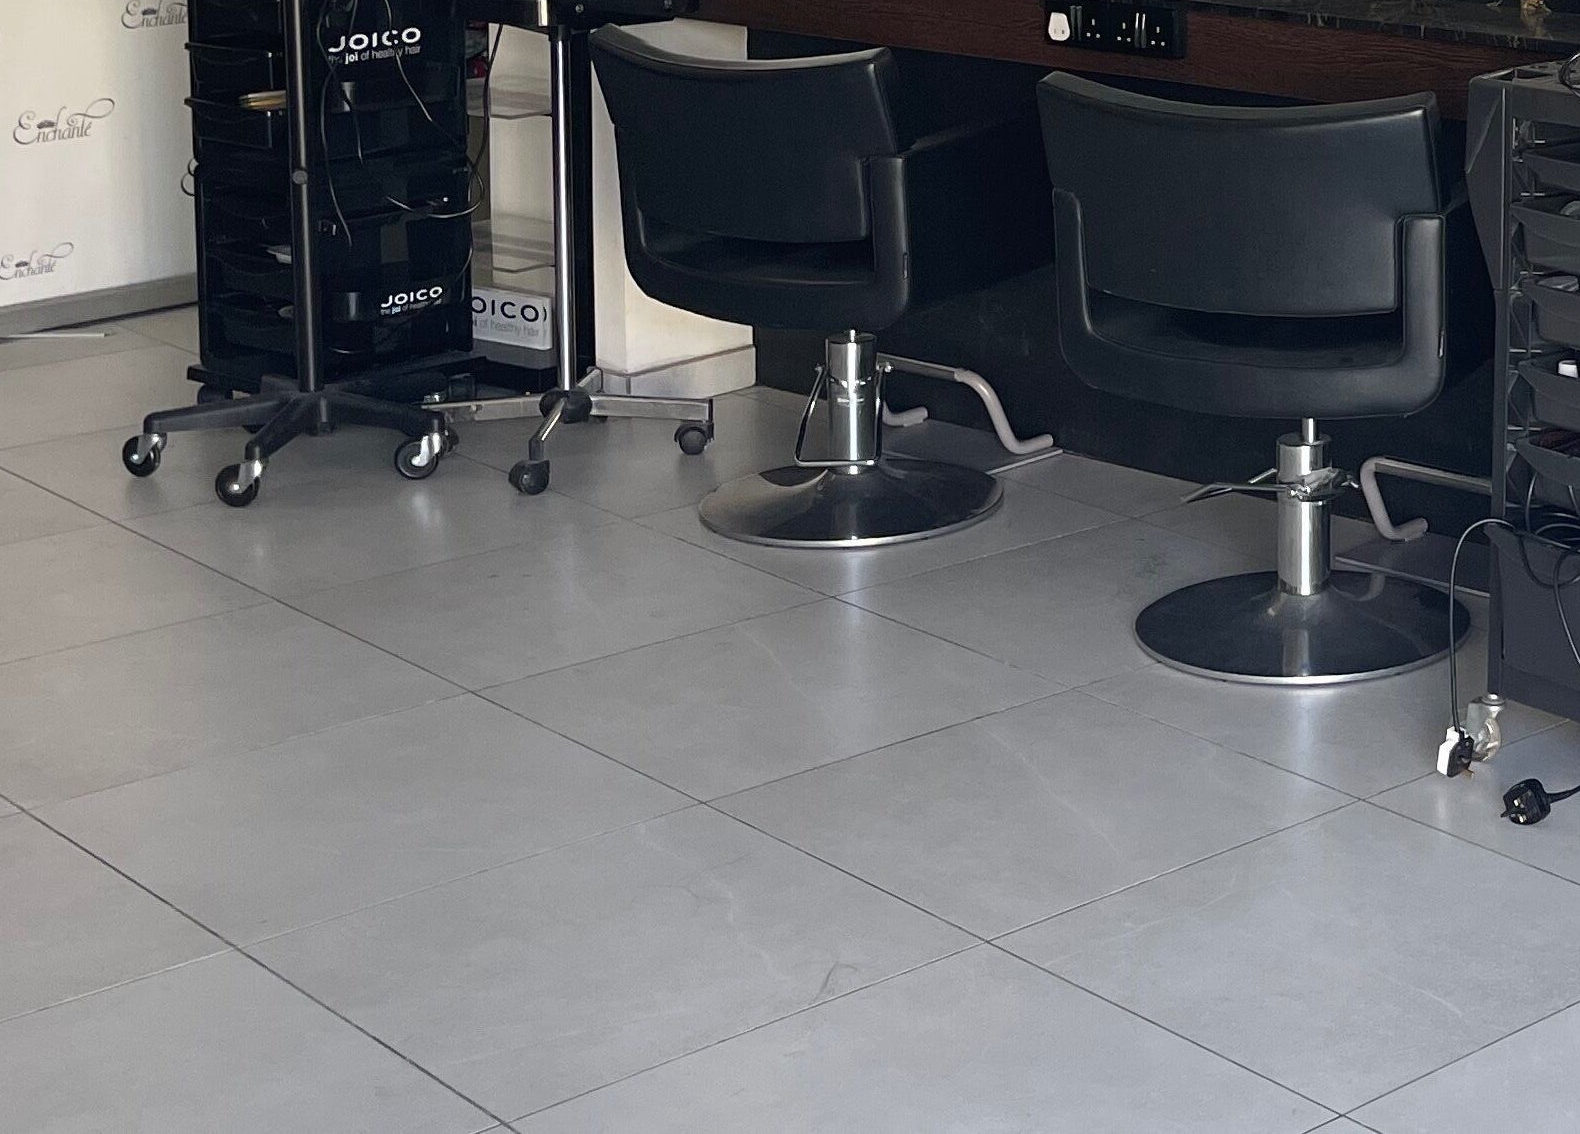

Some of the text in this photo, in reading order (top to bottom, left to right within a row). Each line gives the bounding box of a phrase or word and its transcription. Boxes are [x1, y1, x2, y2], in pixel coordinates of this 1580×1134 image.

[328, 27, 421, 53] JOICO
[381, 286, 443, 307] JOICO
[472, 296, 539, 322] OICO
